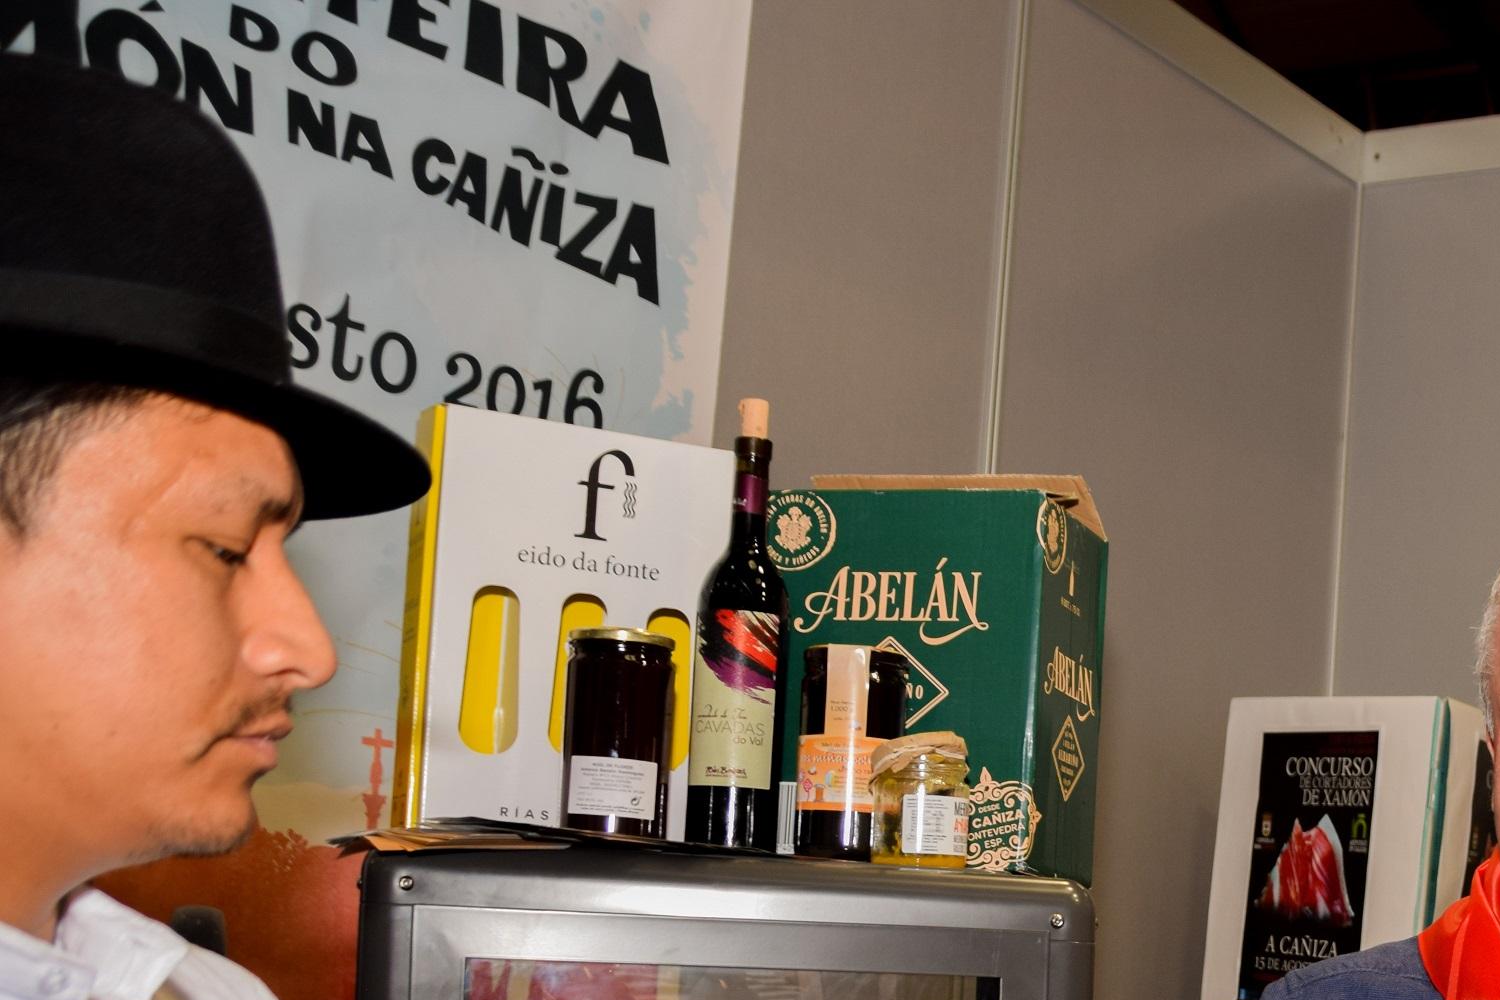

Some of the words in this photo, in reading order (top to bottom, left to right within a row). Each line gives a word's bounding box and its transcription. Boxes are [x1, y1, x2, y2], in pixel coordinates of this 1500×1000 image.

[229, 4, 357, 87] DO
[286, 87, 394, 181] NA
[411, 138, 660, 306] CAÑIZA
[286, 292, 417, 394] sto
[443, 352, 605, 430] 2016
[517, 545, 566, 568] eido
[572, 551, 598, 573] da
[605, 554, 660, 581] fonte
[793, 556, 990, 646] ABELÁN
[1043, 645, 1096, 722] ABELÁN
[695, 719, 767, 737] CAVADAS
[1285, 756, 1375, 777] CONCURSO
[978, 802, 1001, 814] DESDE
[1302, 788, 1320, 806] DE
[1321, 787, 1372, 808] XAMÓN
[971, 807, 1026, 829] CAÑIZA
[967, 821, 1026, 842] ONTEVEDRA
[984, 837, 1006, 849] ESP.
[1264, 934, 1276, 954] A
[1279, 933, 1338, 959] CAÑIZA
